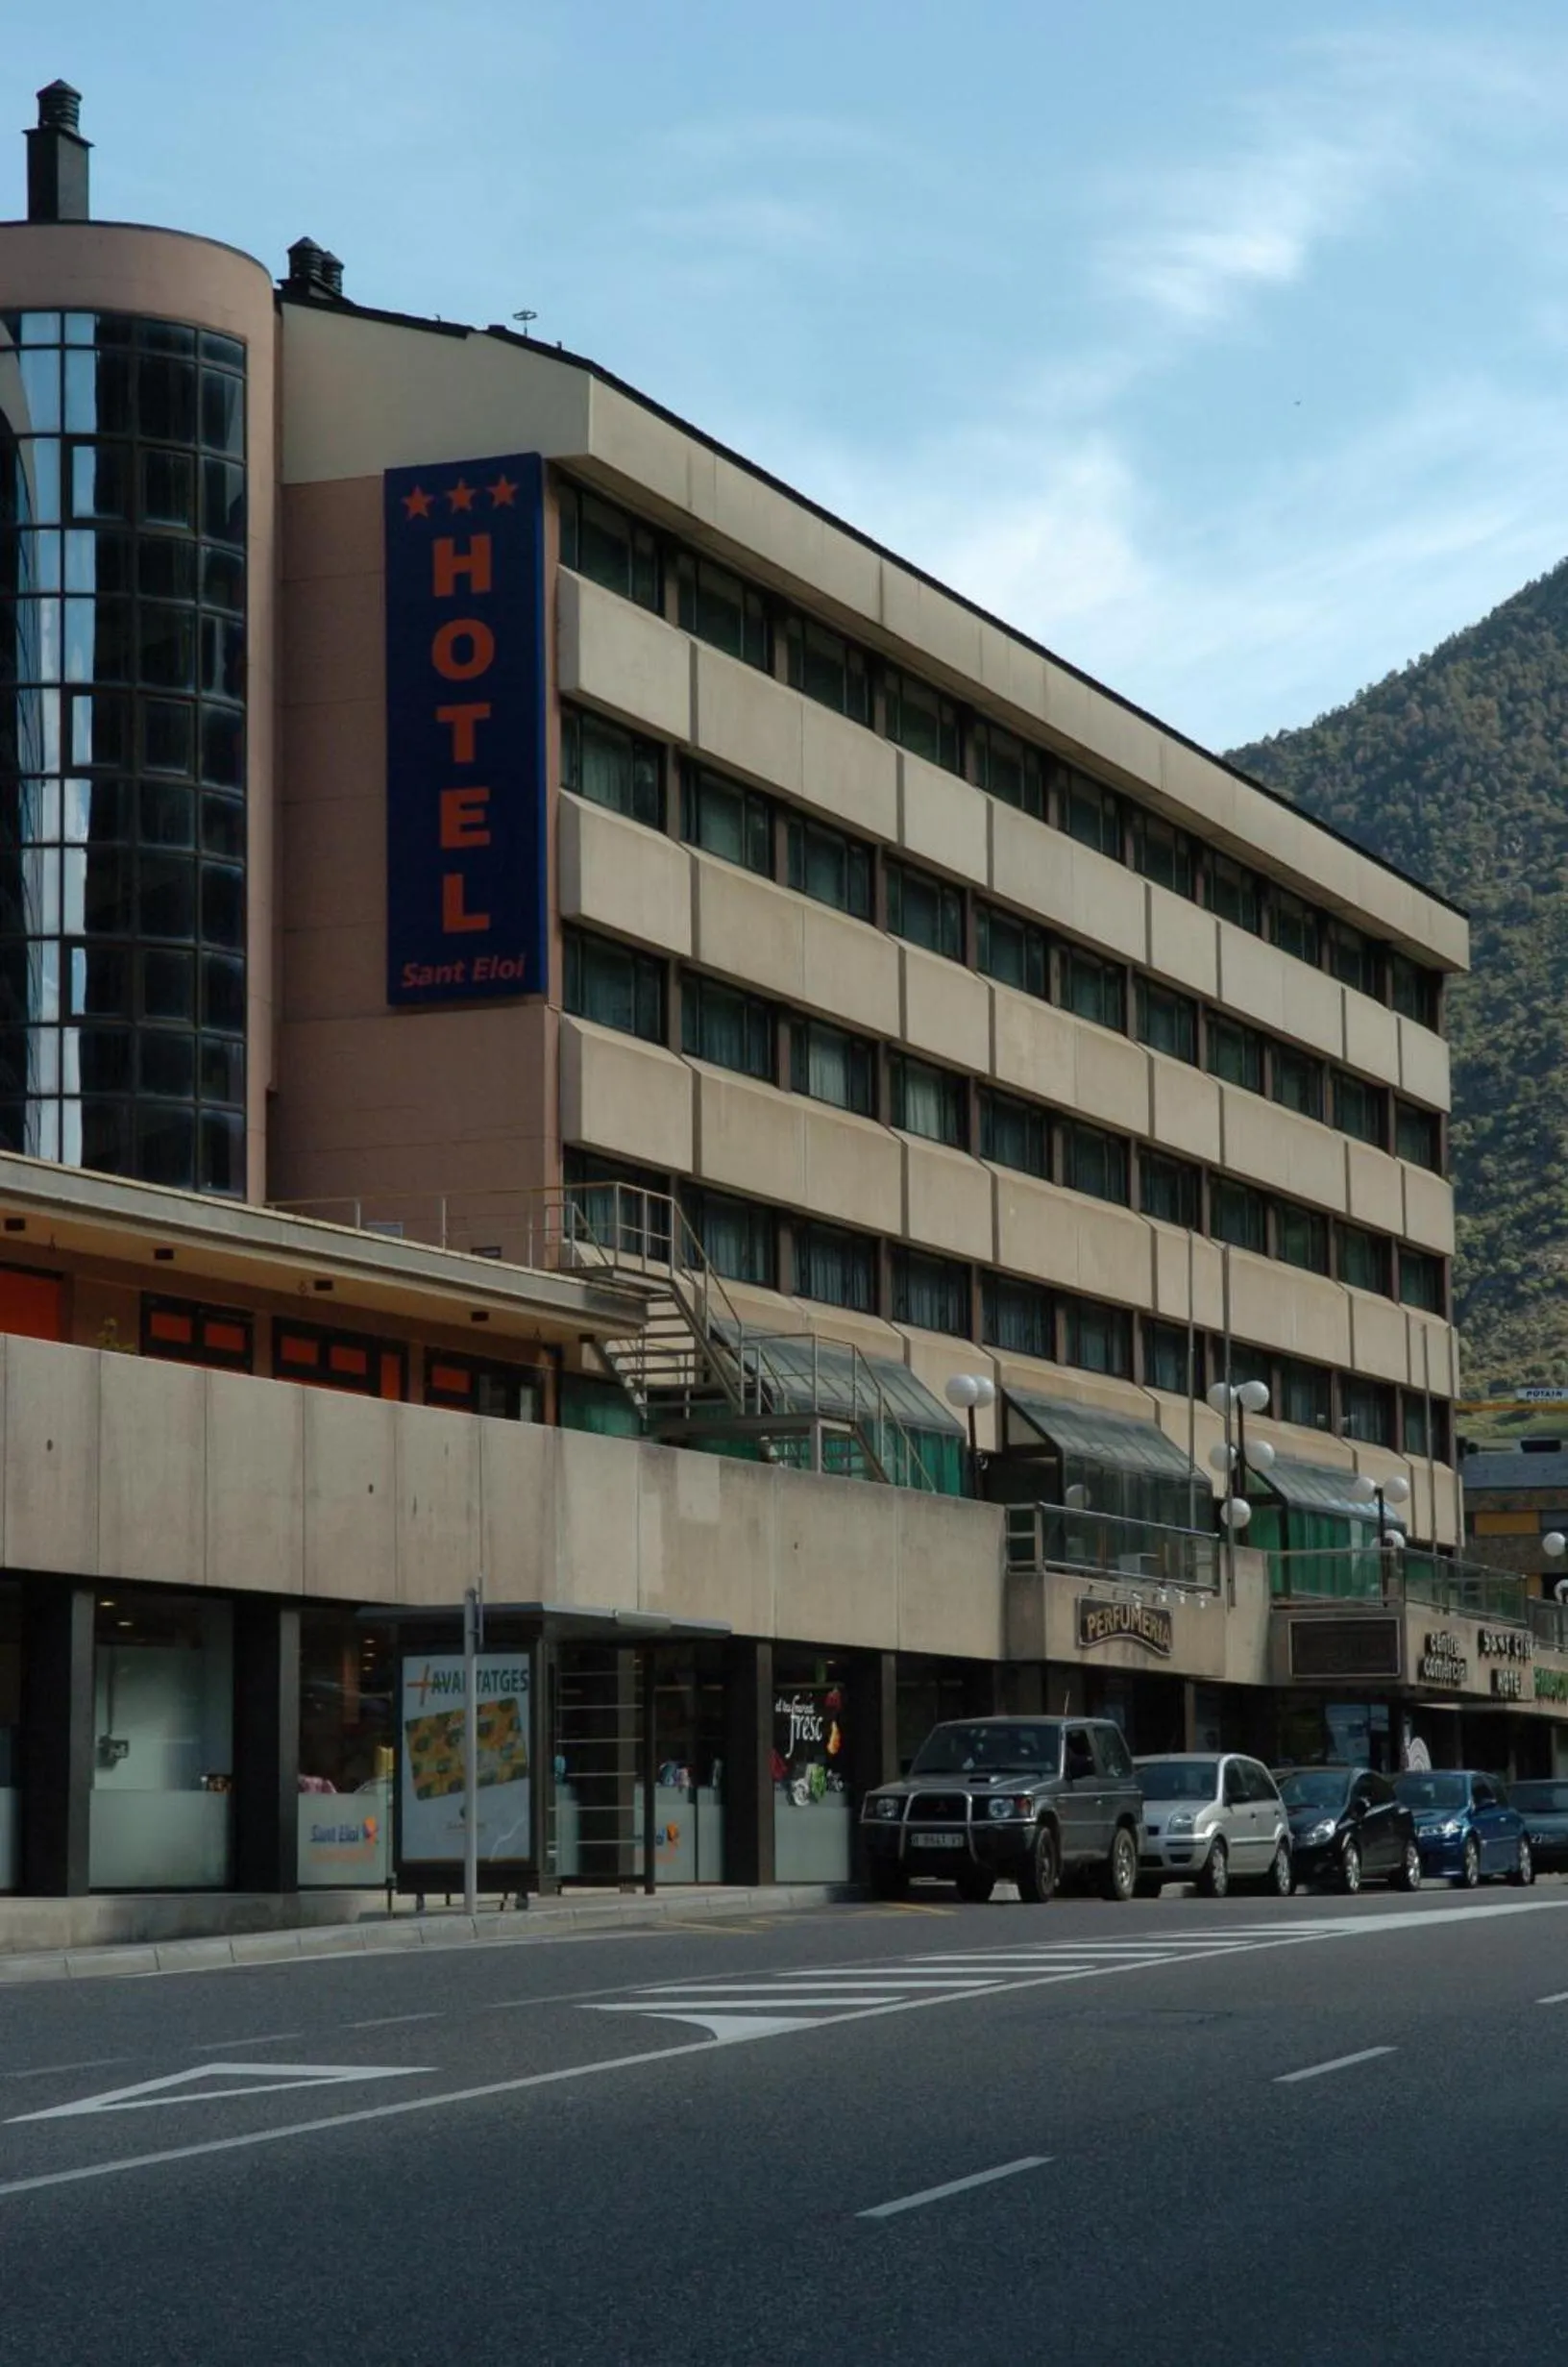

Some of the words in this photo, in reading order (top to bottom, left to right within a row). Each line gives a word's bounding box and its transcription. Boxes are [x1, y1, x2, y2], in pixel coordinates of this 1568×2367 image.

[431, 533, 495, 934] HOTEL
[401, 960, 465, 989] Sant
[472, 952, 527, 982] Eloi
[1087, 1604, 1172, 1649] PERFUMERIA
[784, 1694, 824, 1760] fresc
